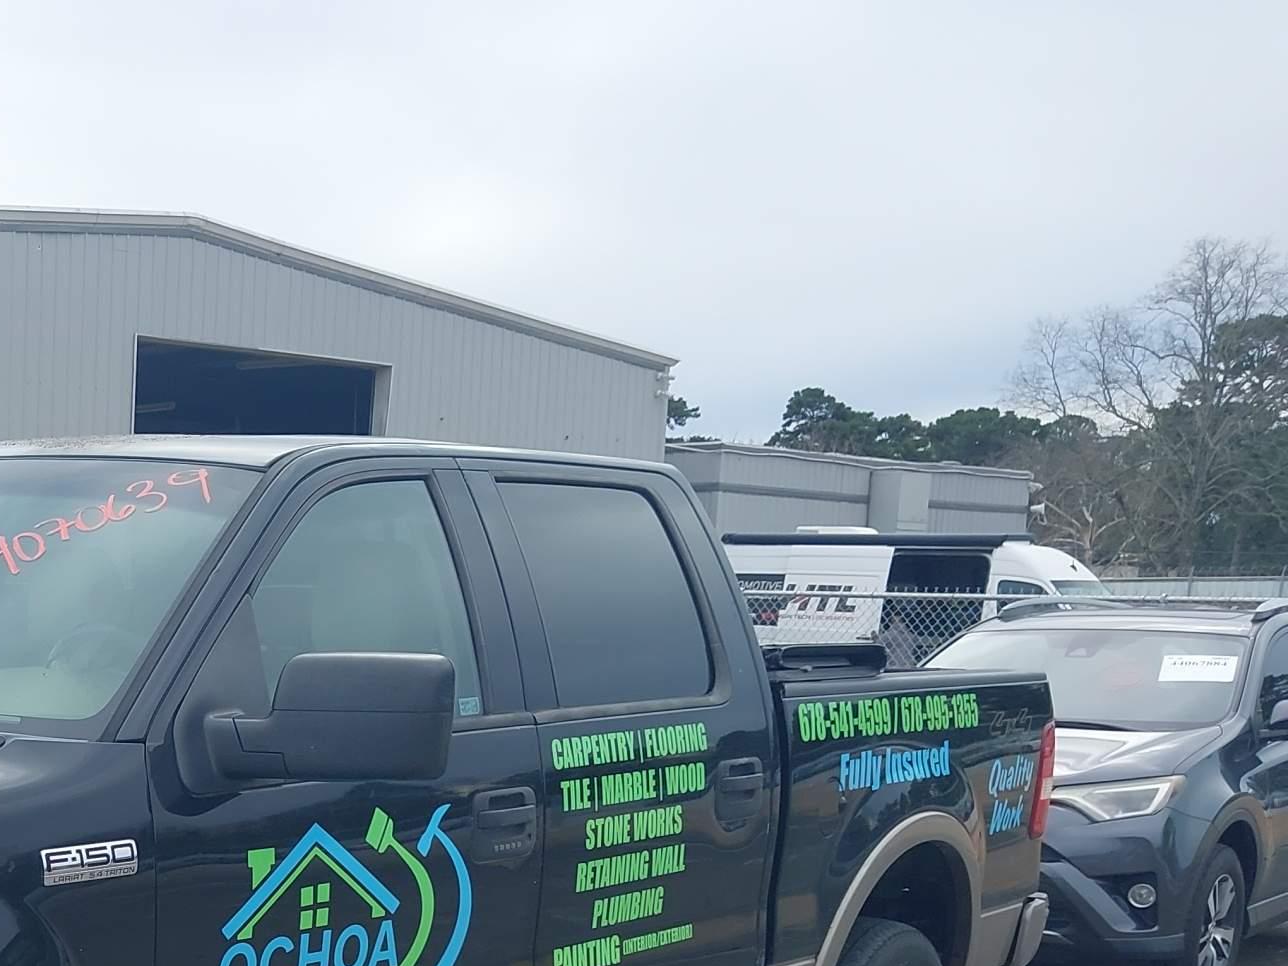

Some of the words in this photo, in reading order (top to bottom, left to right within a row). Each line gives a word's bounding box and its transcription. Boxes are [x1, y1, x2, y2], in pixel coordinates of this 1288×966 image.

[798, 697, 891, 742] 678-541-4599
[901, 693, 979, 733] 678-995-1355
[552, 731, 634, 770] CARPENTRY
[645, 722, 708, 758] FLOORING
[838, 750, 882, 792] Fully
[886, 740, 951, 785] Insured
[560, 778, 591, 811] TILE
[601, 769, 656, 806] MARBLE
[665, 762, 706, 796] WOOD
[988, 754, 1034, 796] Quality
[585, 813, 631, 850] STONE
[633, 805, 683, 841] WORKS
[989, 795, 1024, 835] Work
[45, 842, 135, 872] F-150
[575, 850, 649, 893] RETAINING
[651, 844, 686, 877] WALL
[592, 886, 665, 929] PLUMBING
